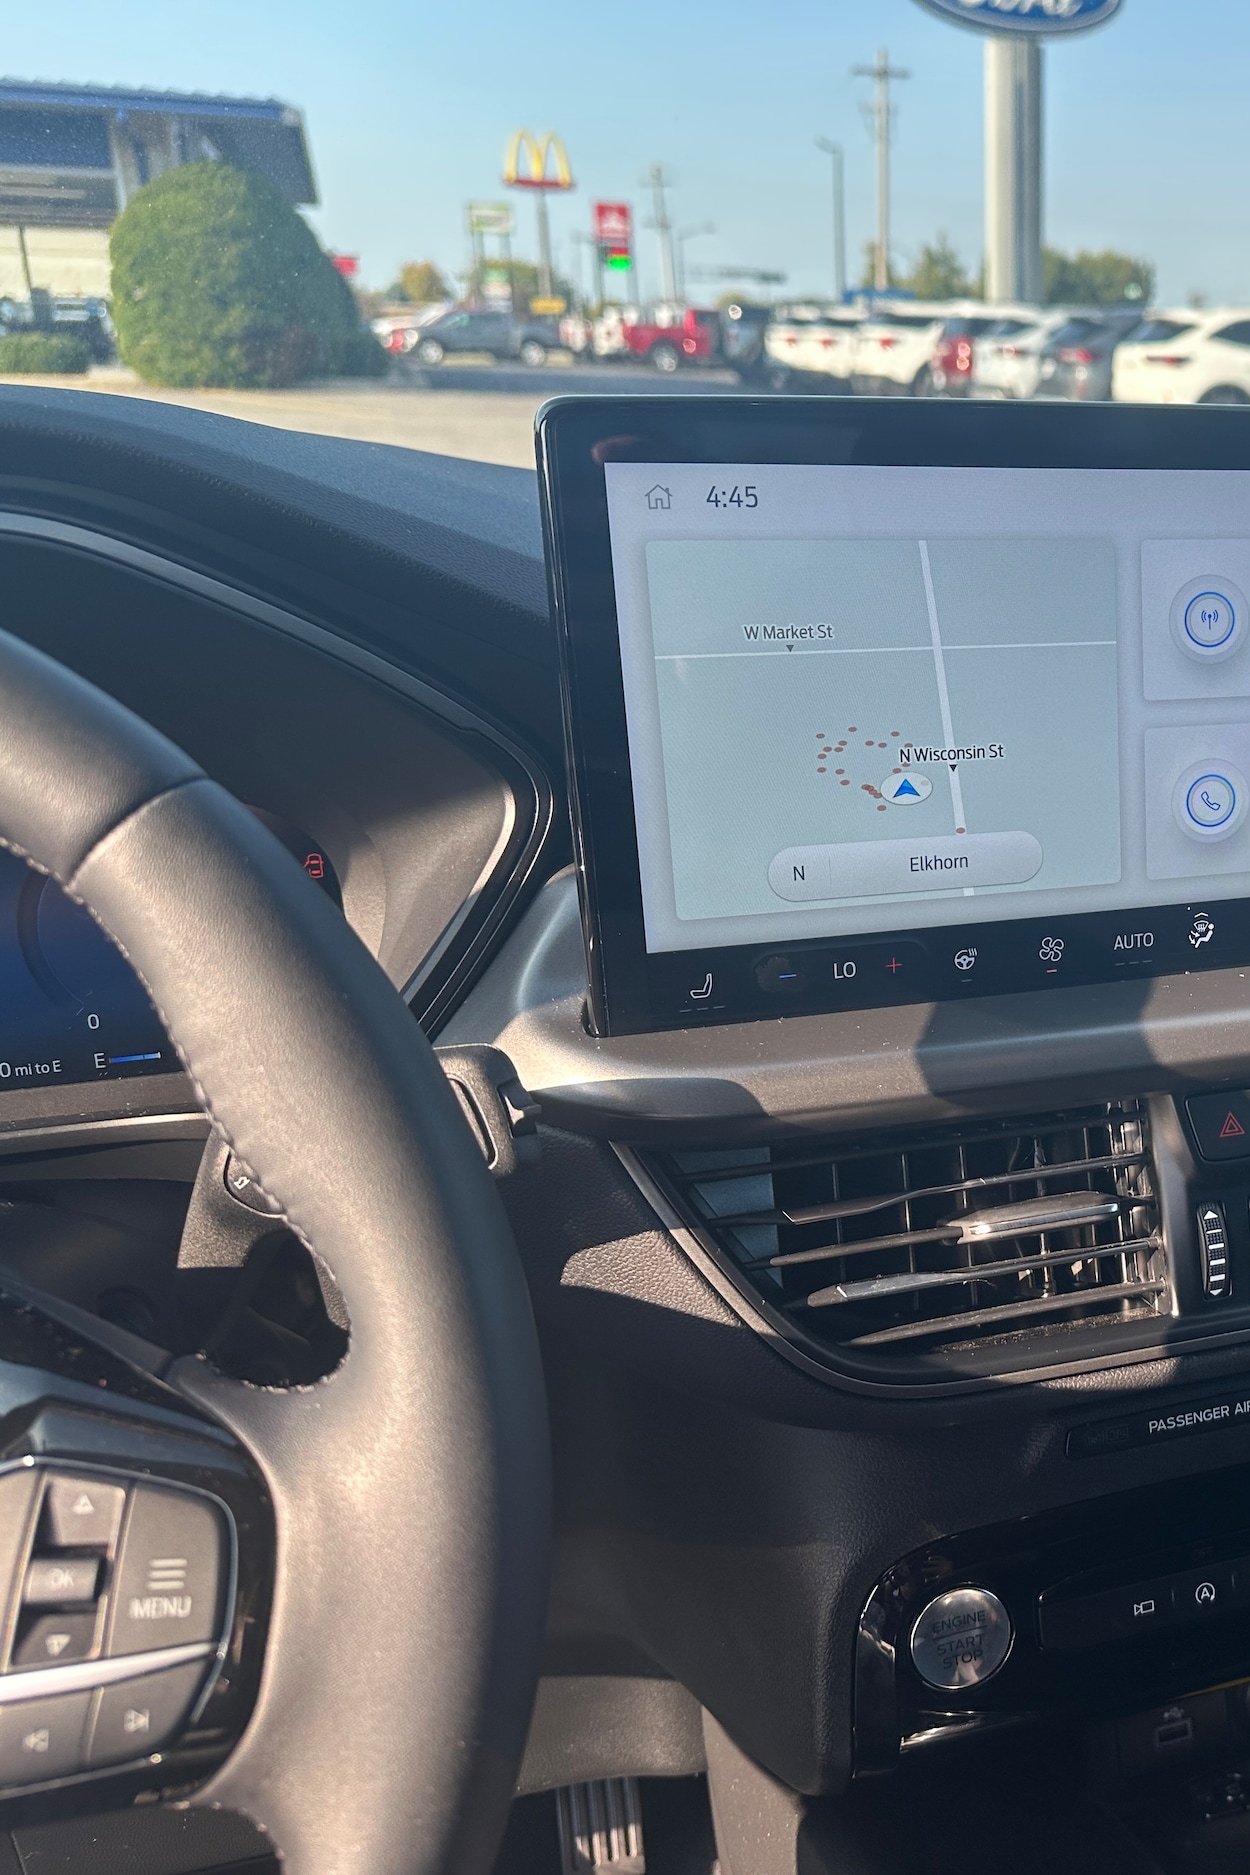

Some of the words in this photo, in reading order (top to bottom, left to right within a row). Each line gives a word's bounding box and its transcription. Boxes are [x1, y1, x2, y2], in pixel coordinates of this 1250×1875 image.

[705, 485, 760, 510] 4:45
[744, 625, 761, 640] W
[762, 624, 817, 641] Market
[819, 622, 834, 639] St
[899, 746, 911, 763] N
[912, 744, 984, 762] Wisconsin
[987, 742, 1005, 760] St
[792, 865, 806, 882] N
[909, 854, 970, 873] Elkhorn
[1113, 931, 1155, 951] AUTO
[833, 960, 857, 980] LO
[87, 1013, 100, 1030] 0
[0, 1062, 11, 1078] 0
[15, 1063, 32, 1077] mi
[34, 1062, 50, 1075] to
[52, 1060, 62, 1073] E
[93, 1052, 107, 1069] E
[1148, 1404, 1231, 1434] PASSENGER
[50, 1568, 74, 1591] OK
[129, 1595, 192, 1619] MENU
[932, 1610, 986, 1634] ENGINE
[937, 1633, 985, 1656] START
[943, 1650, 983, 1669] STOP
